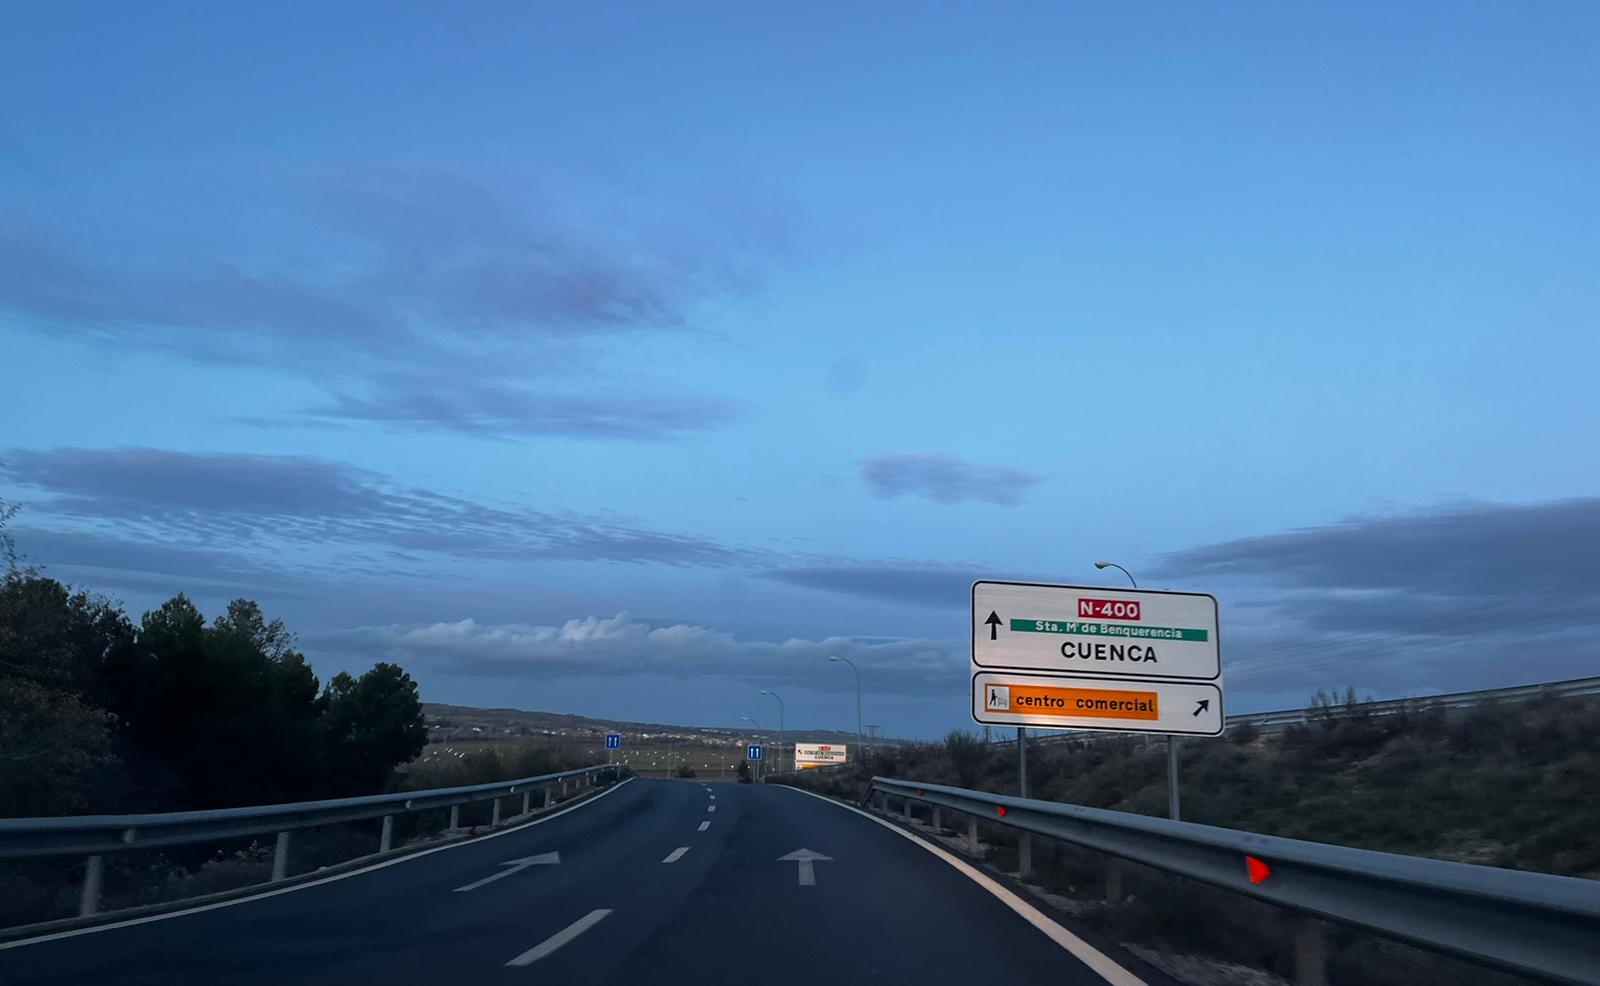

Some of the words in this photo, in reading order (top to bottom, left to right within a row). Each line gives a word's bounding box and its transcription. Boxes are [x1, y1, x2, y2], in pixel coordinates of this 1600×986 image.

[1080, 601, 1138, 618] N-400
[1035, 621, 1063, 632] Sta.
[1081, 624, 1097, 634] de
[1100, 624, 1183, 638] Benquerencia
[1061, 642, 1157, 663] CUENCA
[1016, 694, 1065, 708] centro
[1076, 697, 1154, 712] comercial
